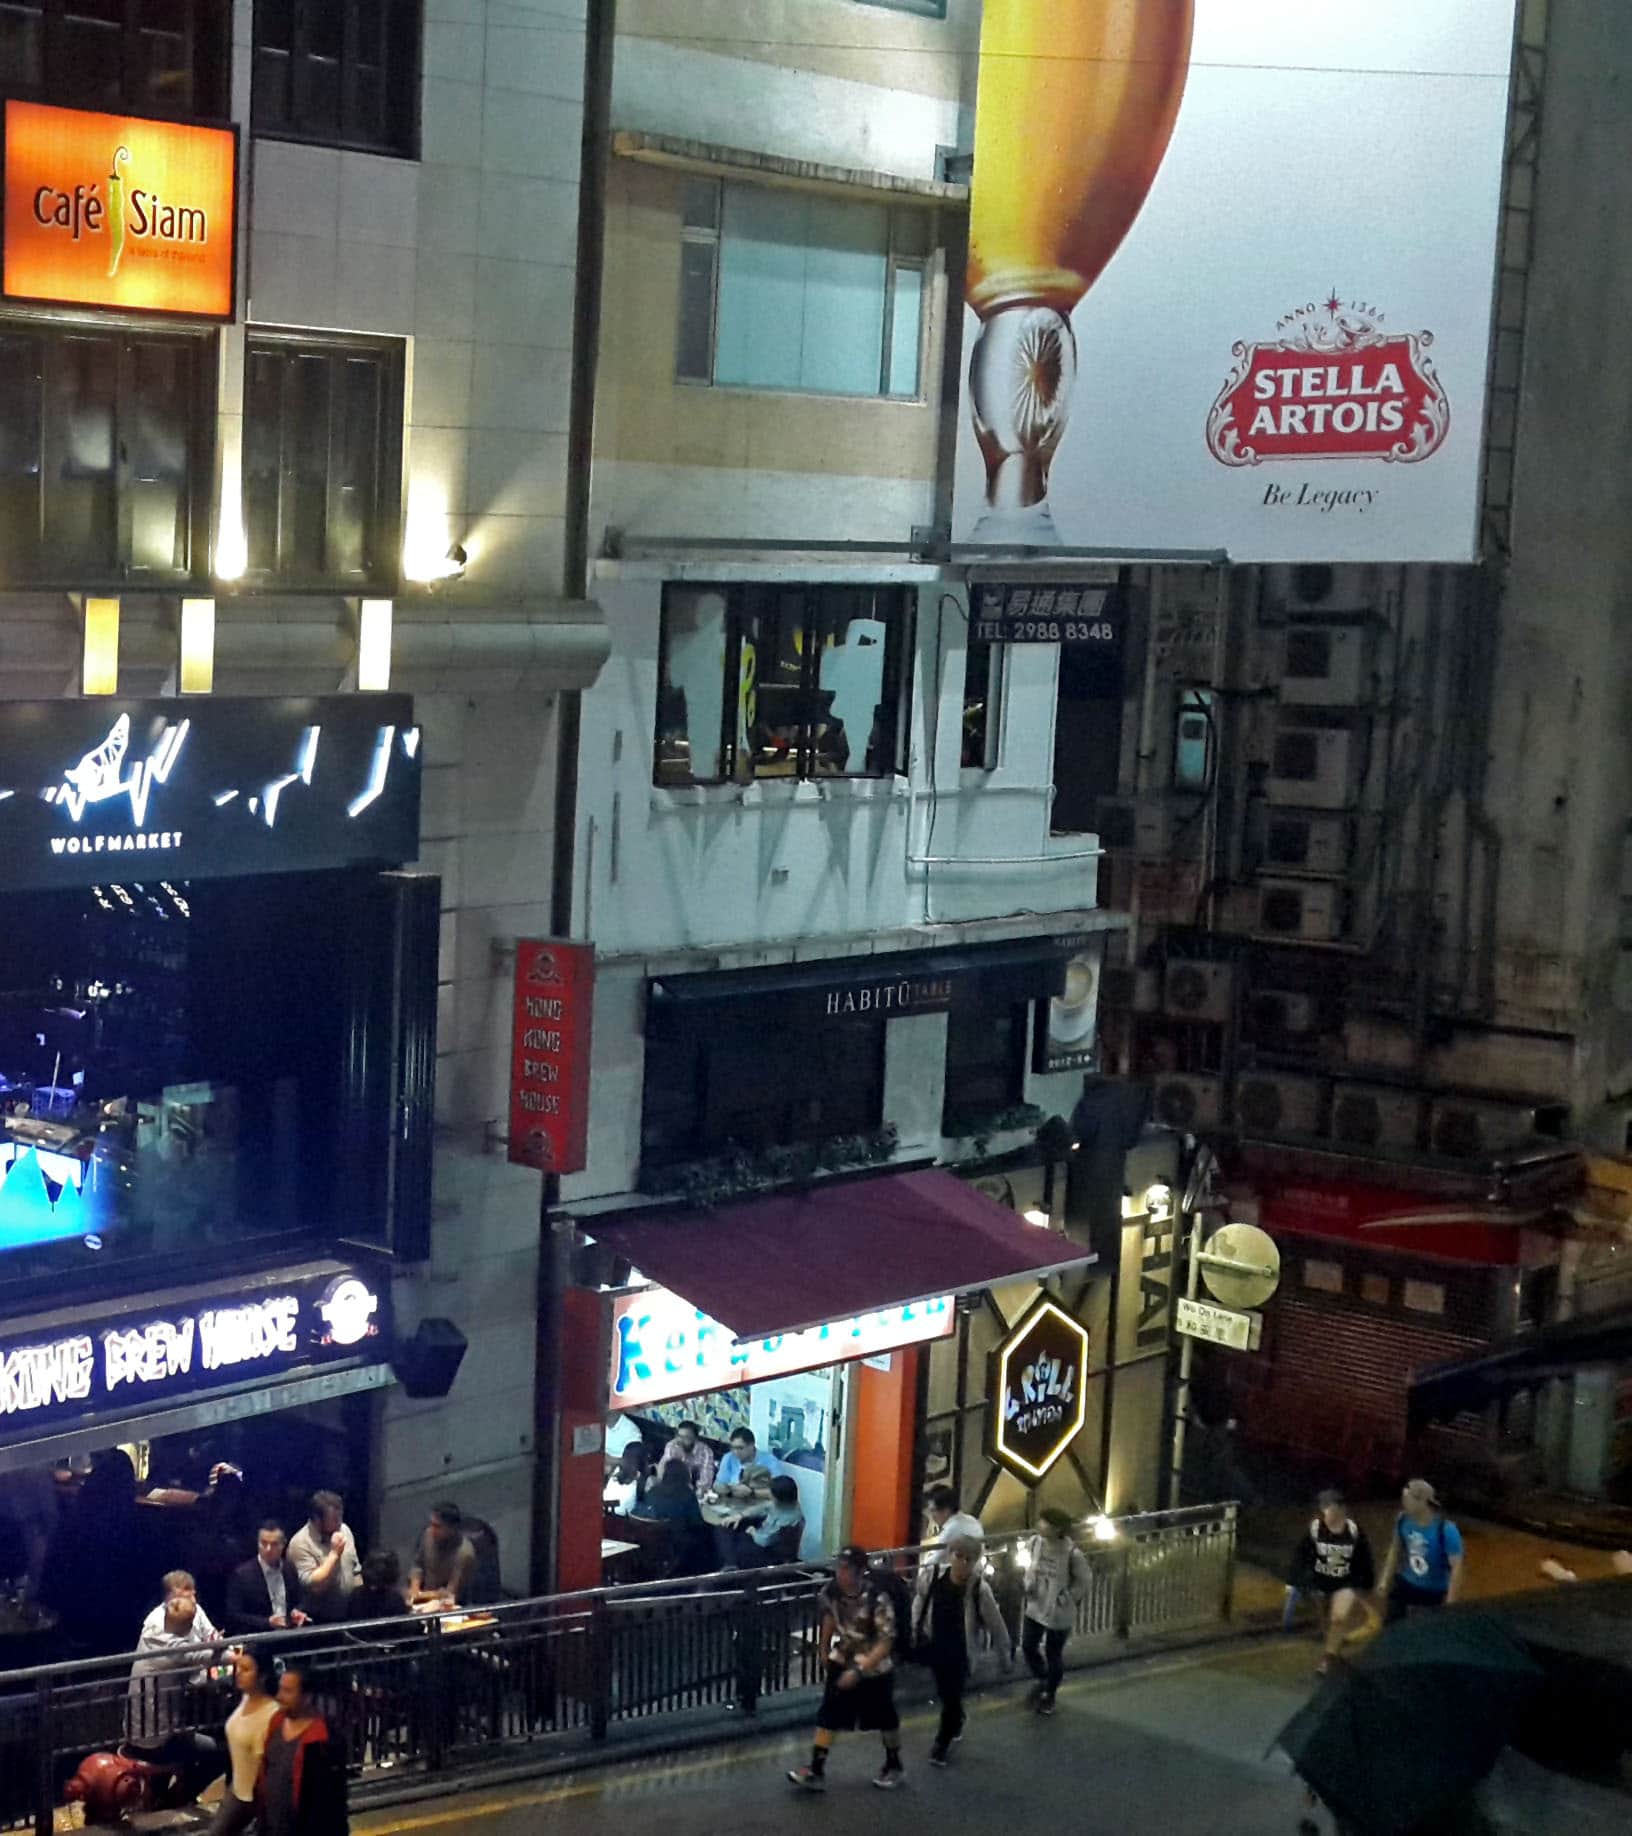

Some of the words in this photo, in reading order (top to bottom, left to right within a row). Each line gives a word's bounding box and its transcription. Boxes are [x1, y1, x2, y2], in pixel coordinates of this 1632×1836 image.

[33, 183, 103, 241] Café
[129, 188, 207, 244] Siam
[1275, 301, 1317, 332] ANNO
[1253, 363, 1406, 400] STELLA
[1248, 401, 1404, 436] ARTOIS
[1262, 482, 1293, 506] Be
[1296, 482, 1380, 513] Legacy
[1065, 622, 1114, 641] 8348
[50, 831, 184, 855] WOLFMARKET
[103, 1316, 195, 1393] BREW
